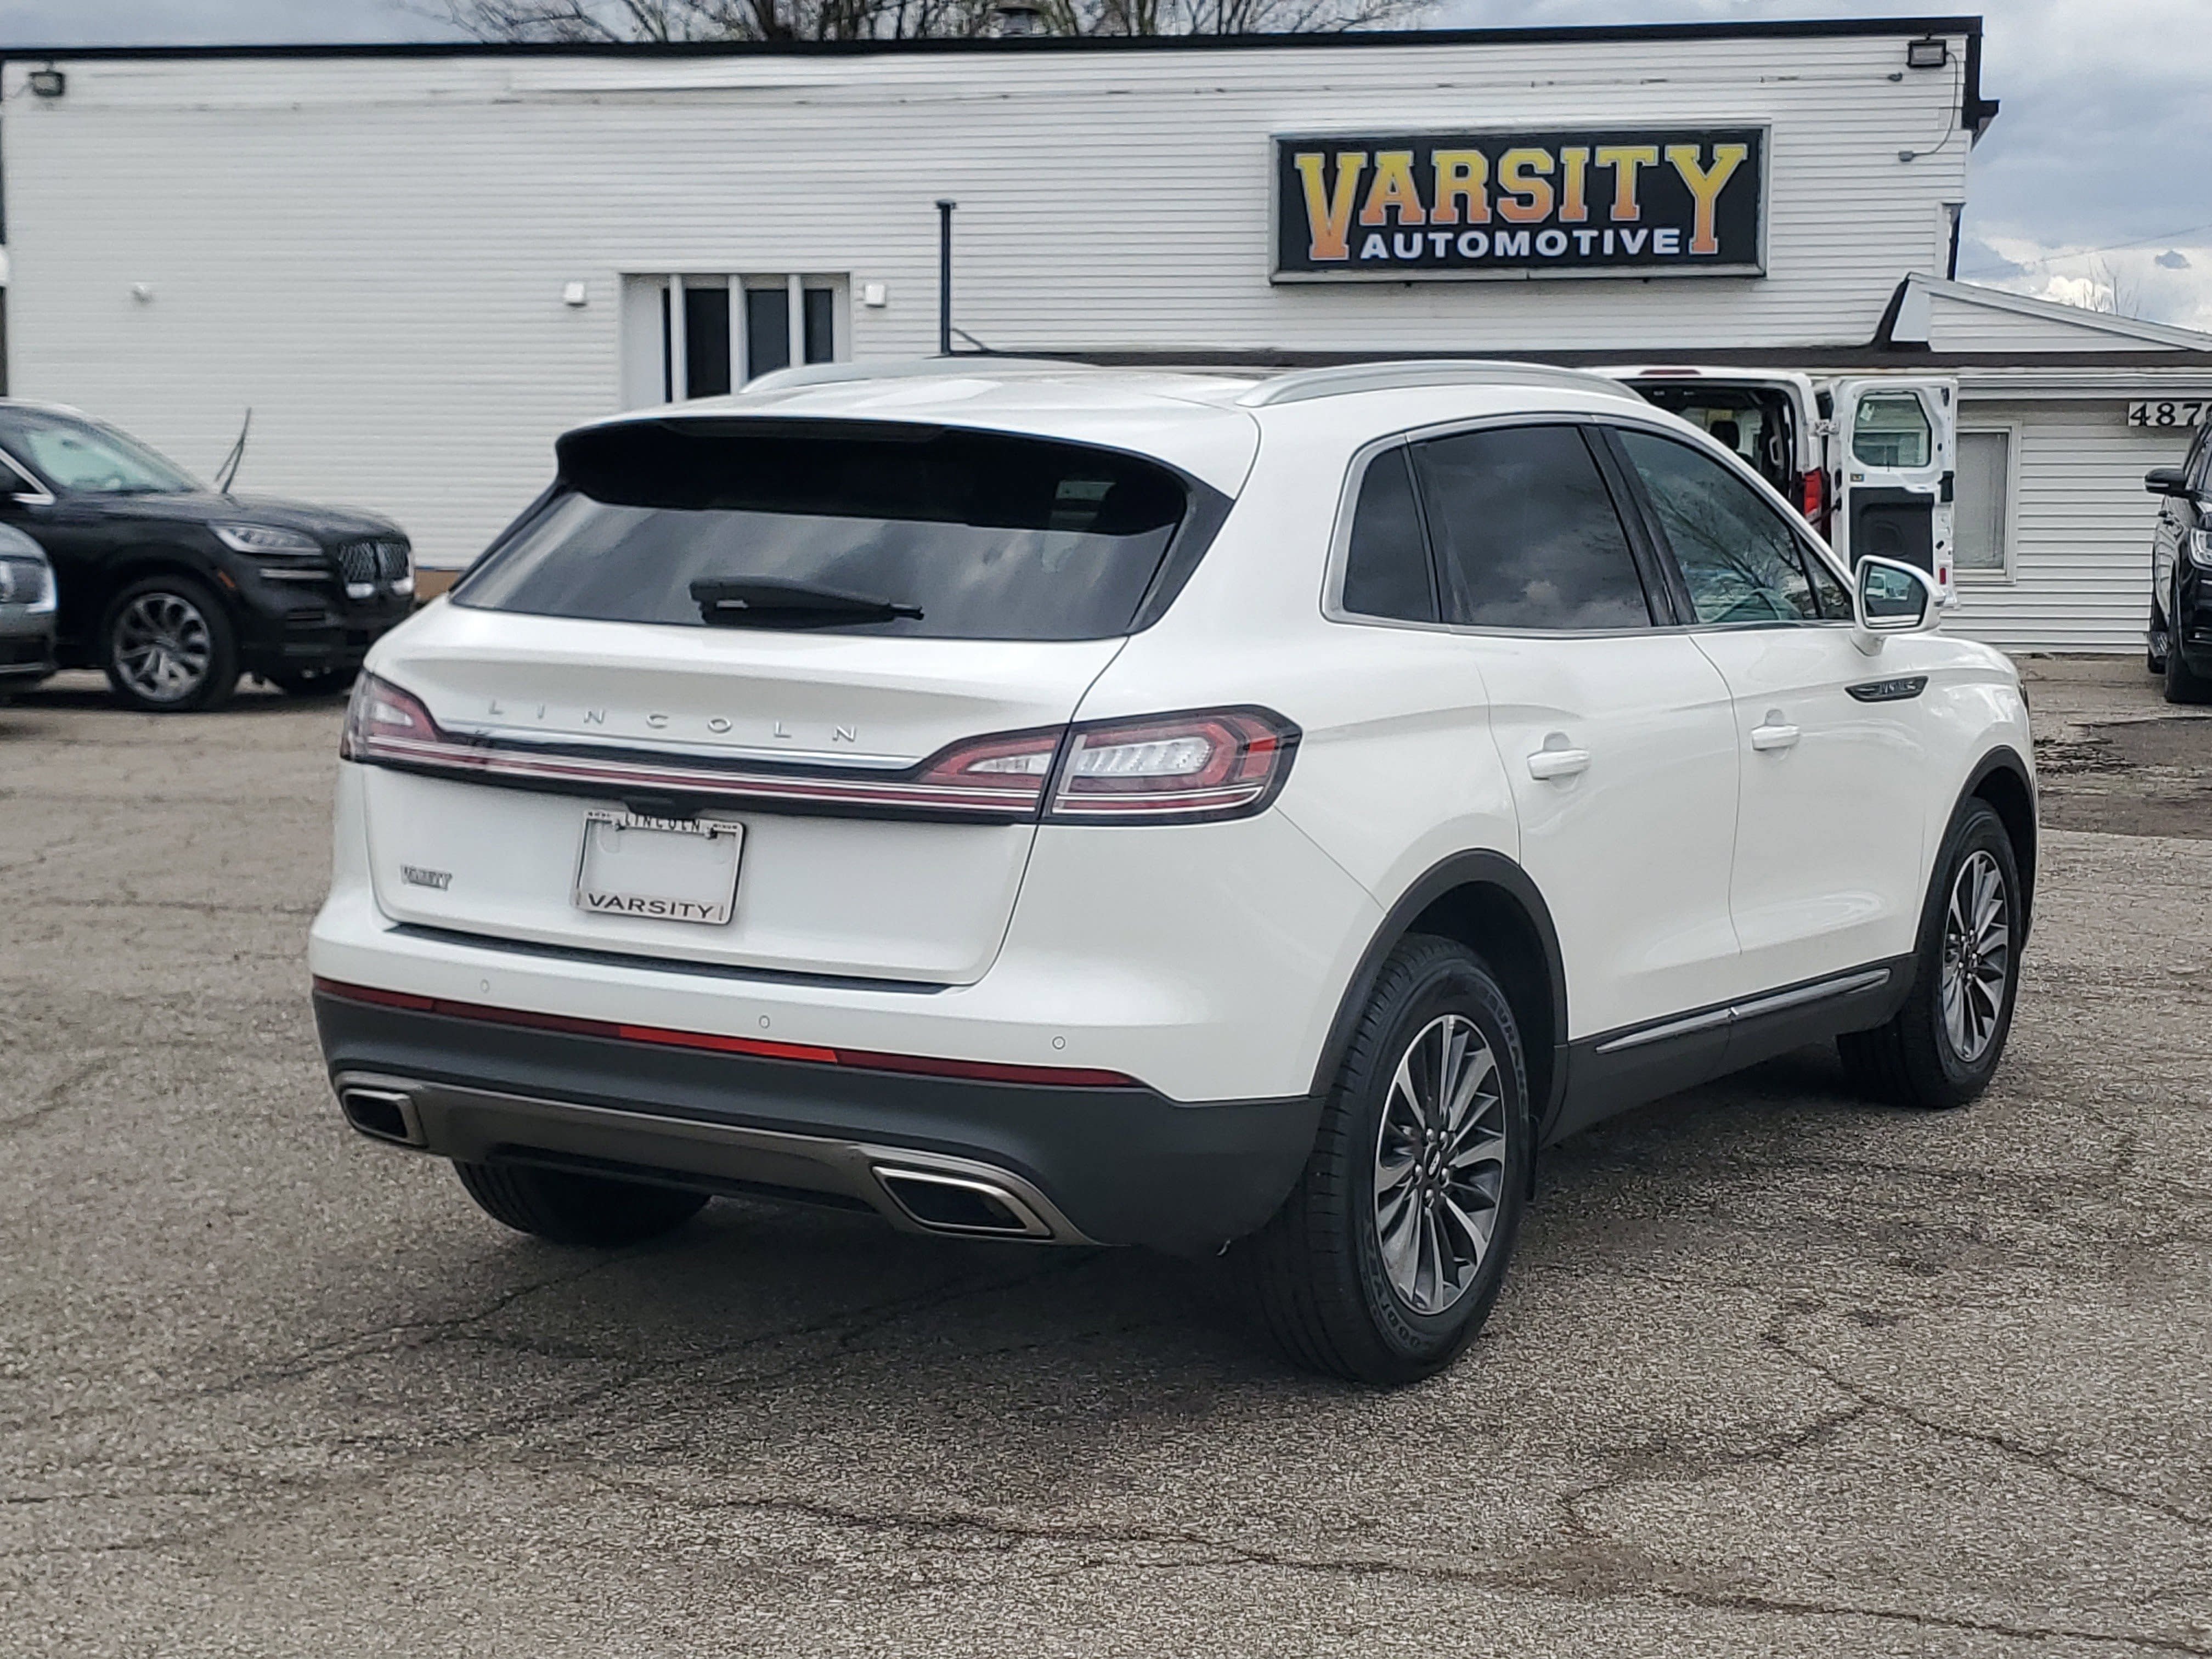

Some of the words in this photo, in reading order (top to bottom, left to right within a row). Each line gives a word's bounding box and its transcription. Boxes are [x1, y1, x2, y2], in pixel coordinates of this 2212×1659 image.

[1293, 144, 1749, 261] VARSITY
[1361, 228, 1681, 259] AUTOMOTIVE
[2130, 402, 2212, 426] 487
[489, 699, 858, 743] LINCOLN
[588, 892, 714, 919] VARSITY
